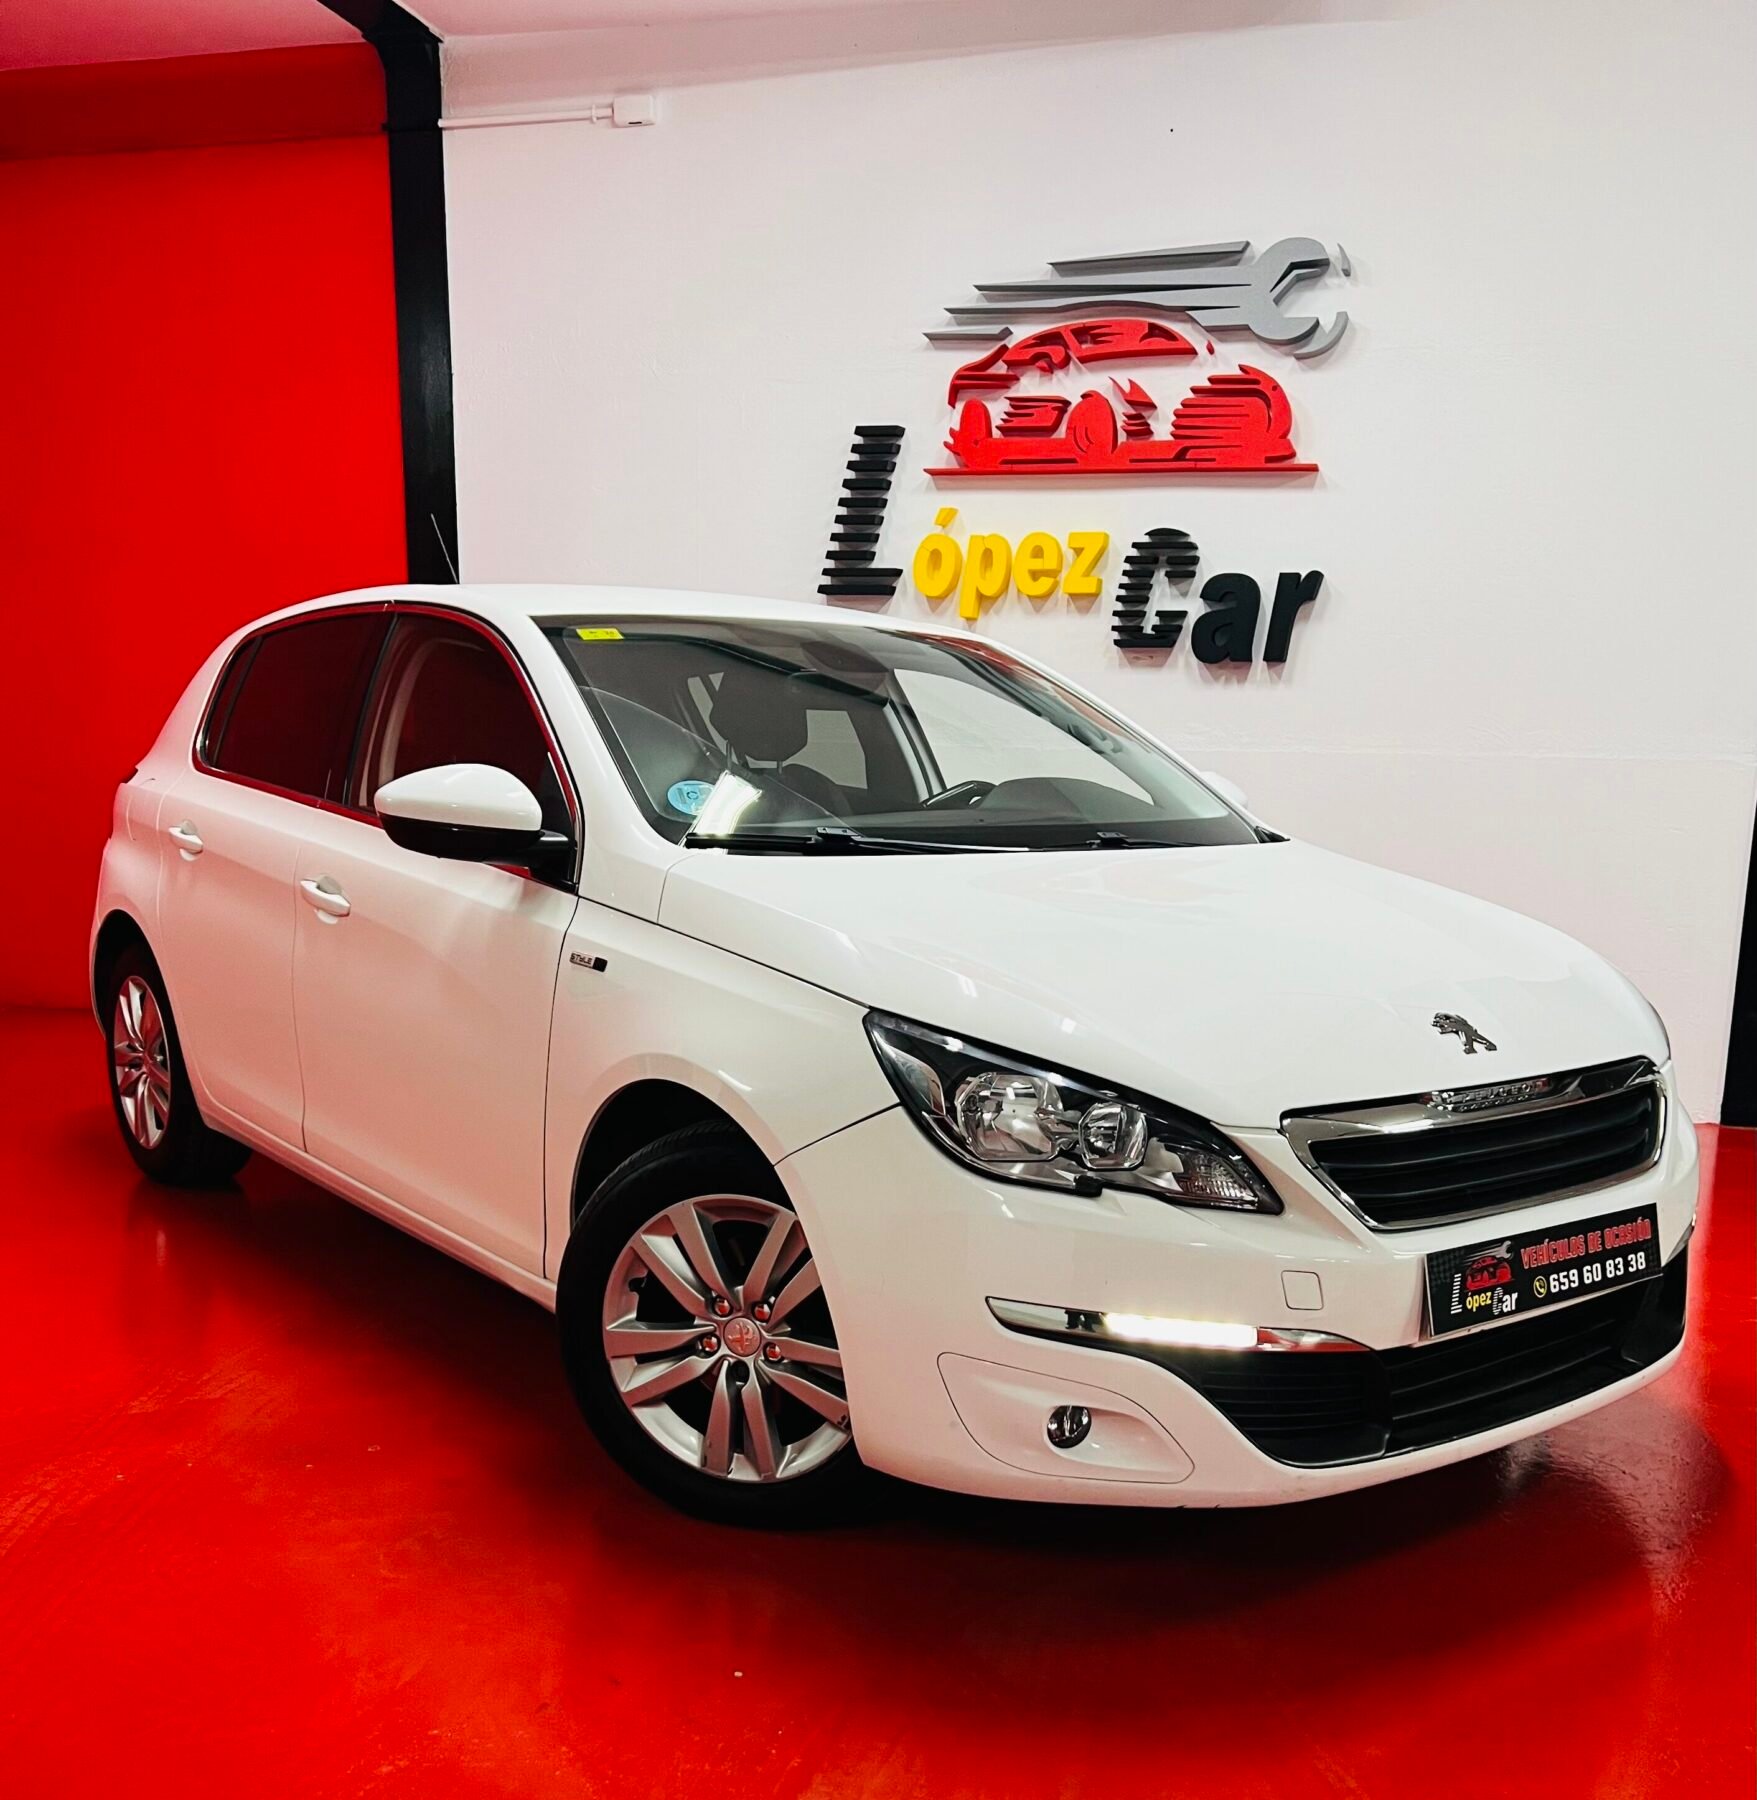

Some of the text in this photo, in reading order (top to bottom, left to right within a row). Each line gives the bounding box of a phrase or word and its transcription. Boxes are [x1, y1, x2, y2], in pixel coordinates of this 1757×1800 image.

[1111, 527, 1324, 664] Car
[1520, 1217, 1652, 1269] VEHÍCULOS DE OCASIÓN
[1549, 1251, 1646, 1293] 659 60 83 38
[1492, 1287, 1518, 1315] Car
